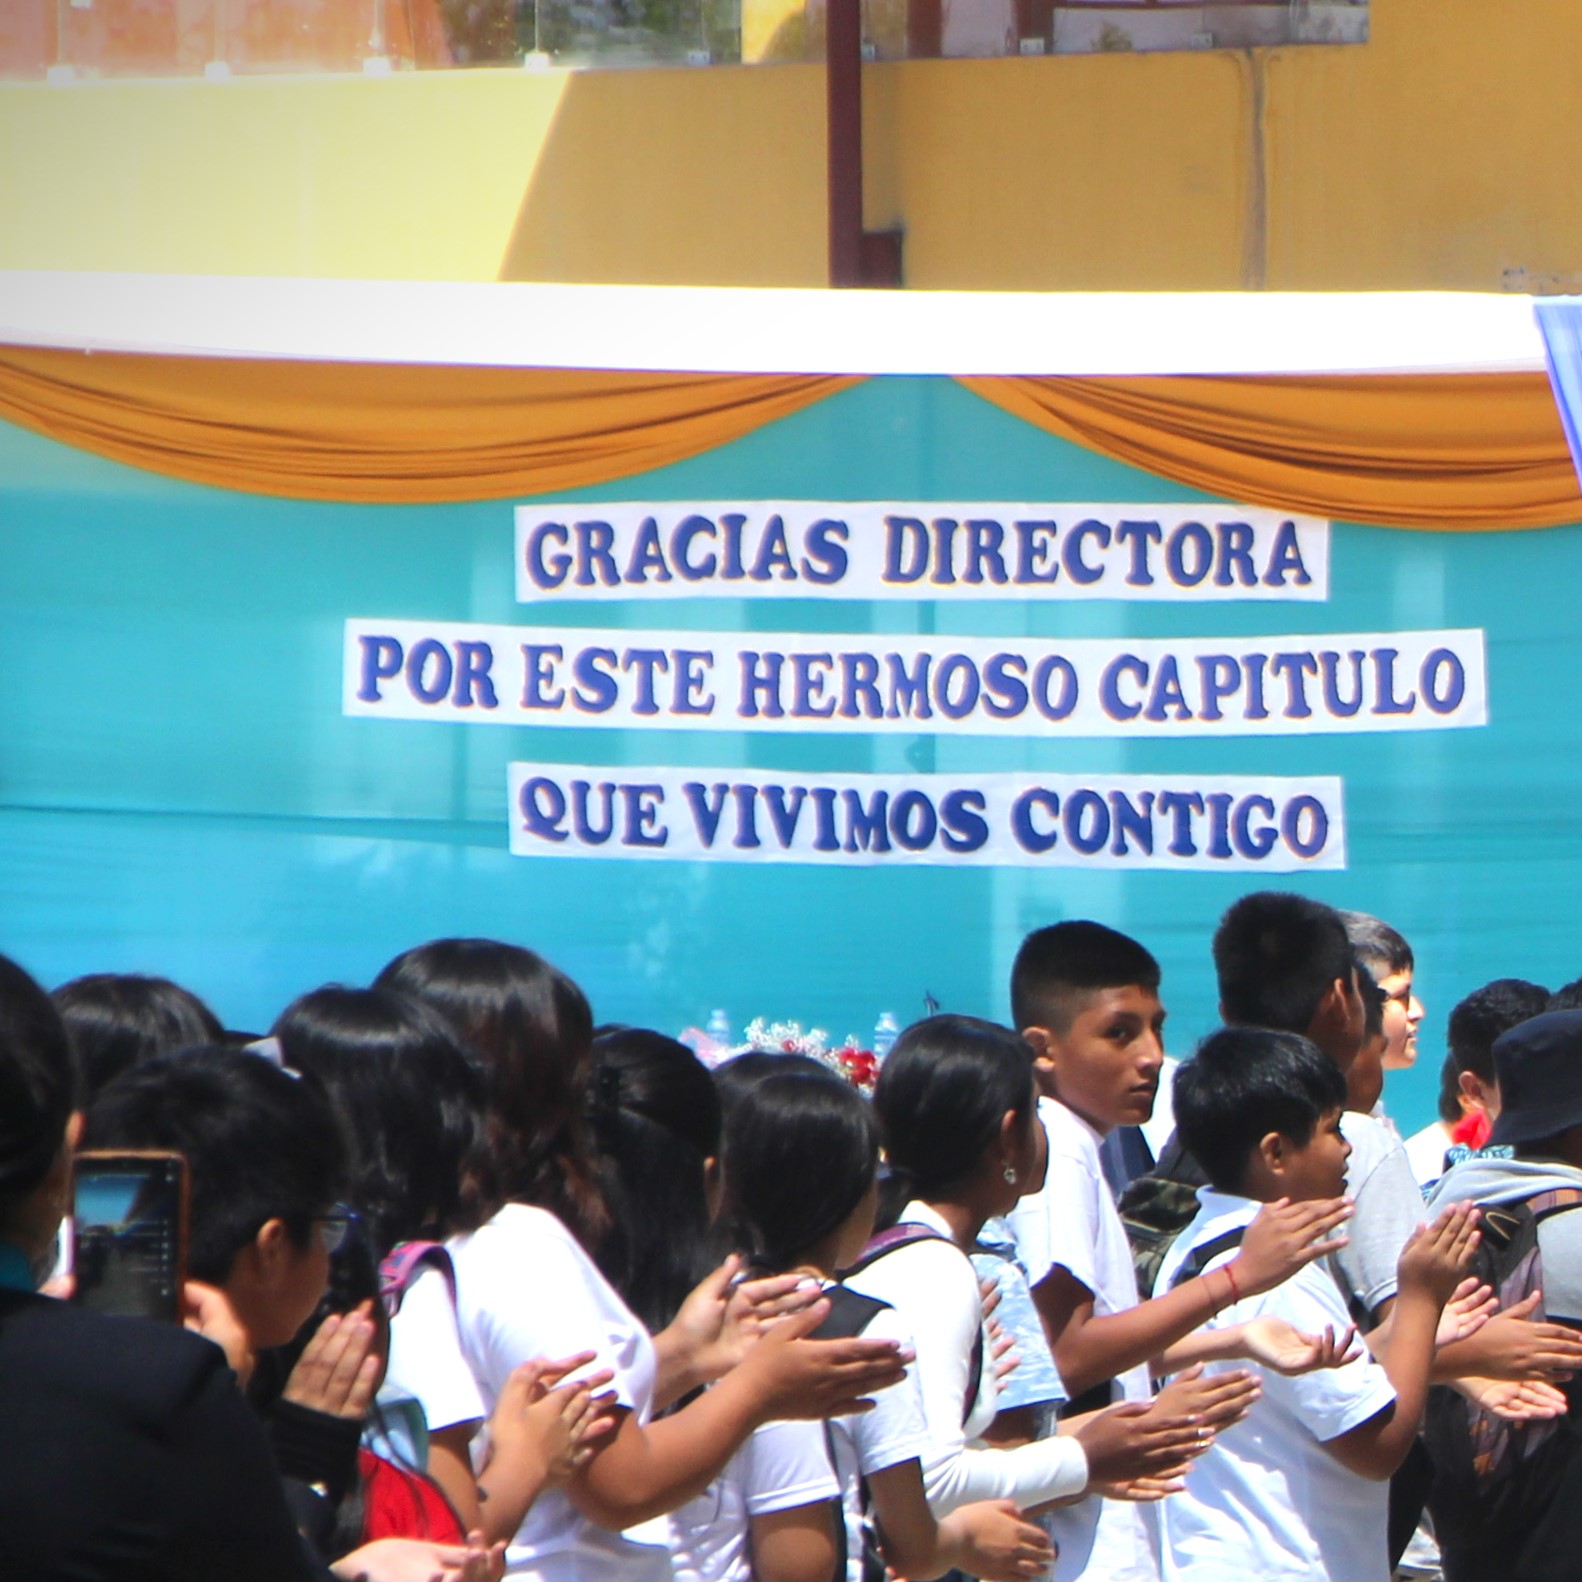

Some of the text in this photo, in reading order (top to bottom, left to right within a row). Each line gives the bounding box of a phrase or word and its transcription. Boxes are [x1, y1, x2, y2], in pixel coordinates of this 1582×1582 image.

[526, 512, 1313, 590] GRACIAS DIRECTORA
[359, 635, 1466, 722] POR ESTE HERMOSO CAPITULO
[519, 776, 1330, 861] QUE VIVIMOS CONTIGO
